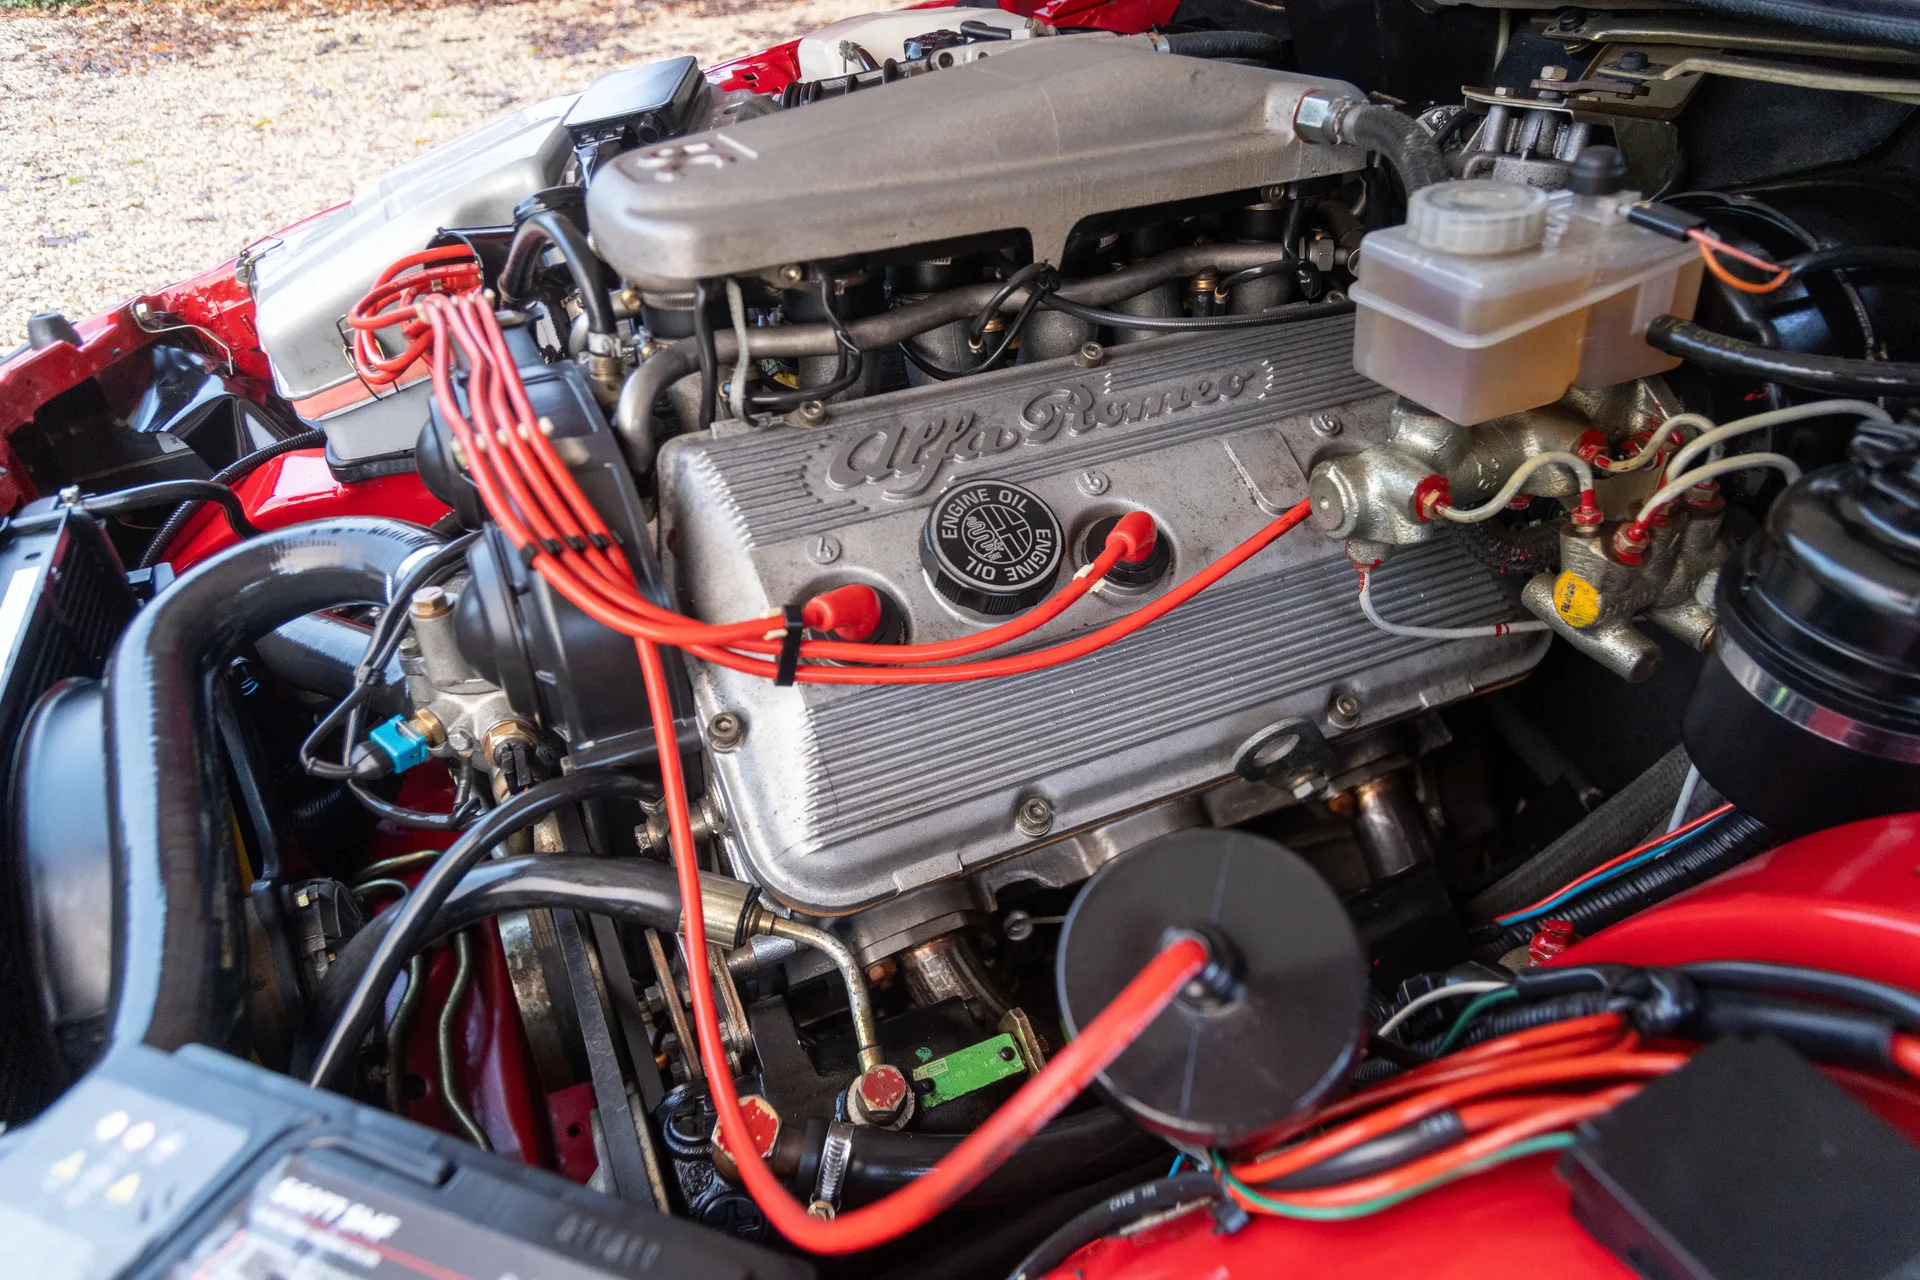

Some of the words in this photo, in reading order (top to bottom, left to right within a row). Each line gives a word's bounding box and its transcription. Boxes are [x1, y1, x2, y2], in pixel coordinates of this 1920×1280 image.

[826, 410, 1018, 502] Alfa
[1019, 369, 1254, 447] Romeo
[941, 488, 991, 539] ENGINE
[998, 489, 1028, 513] OIL
[965, 556, 996, 581] OIL
[1004, 529, 1053, 582] ENGINE
